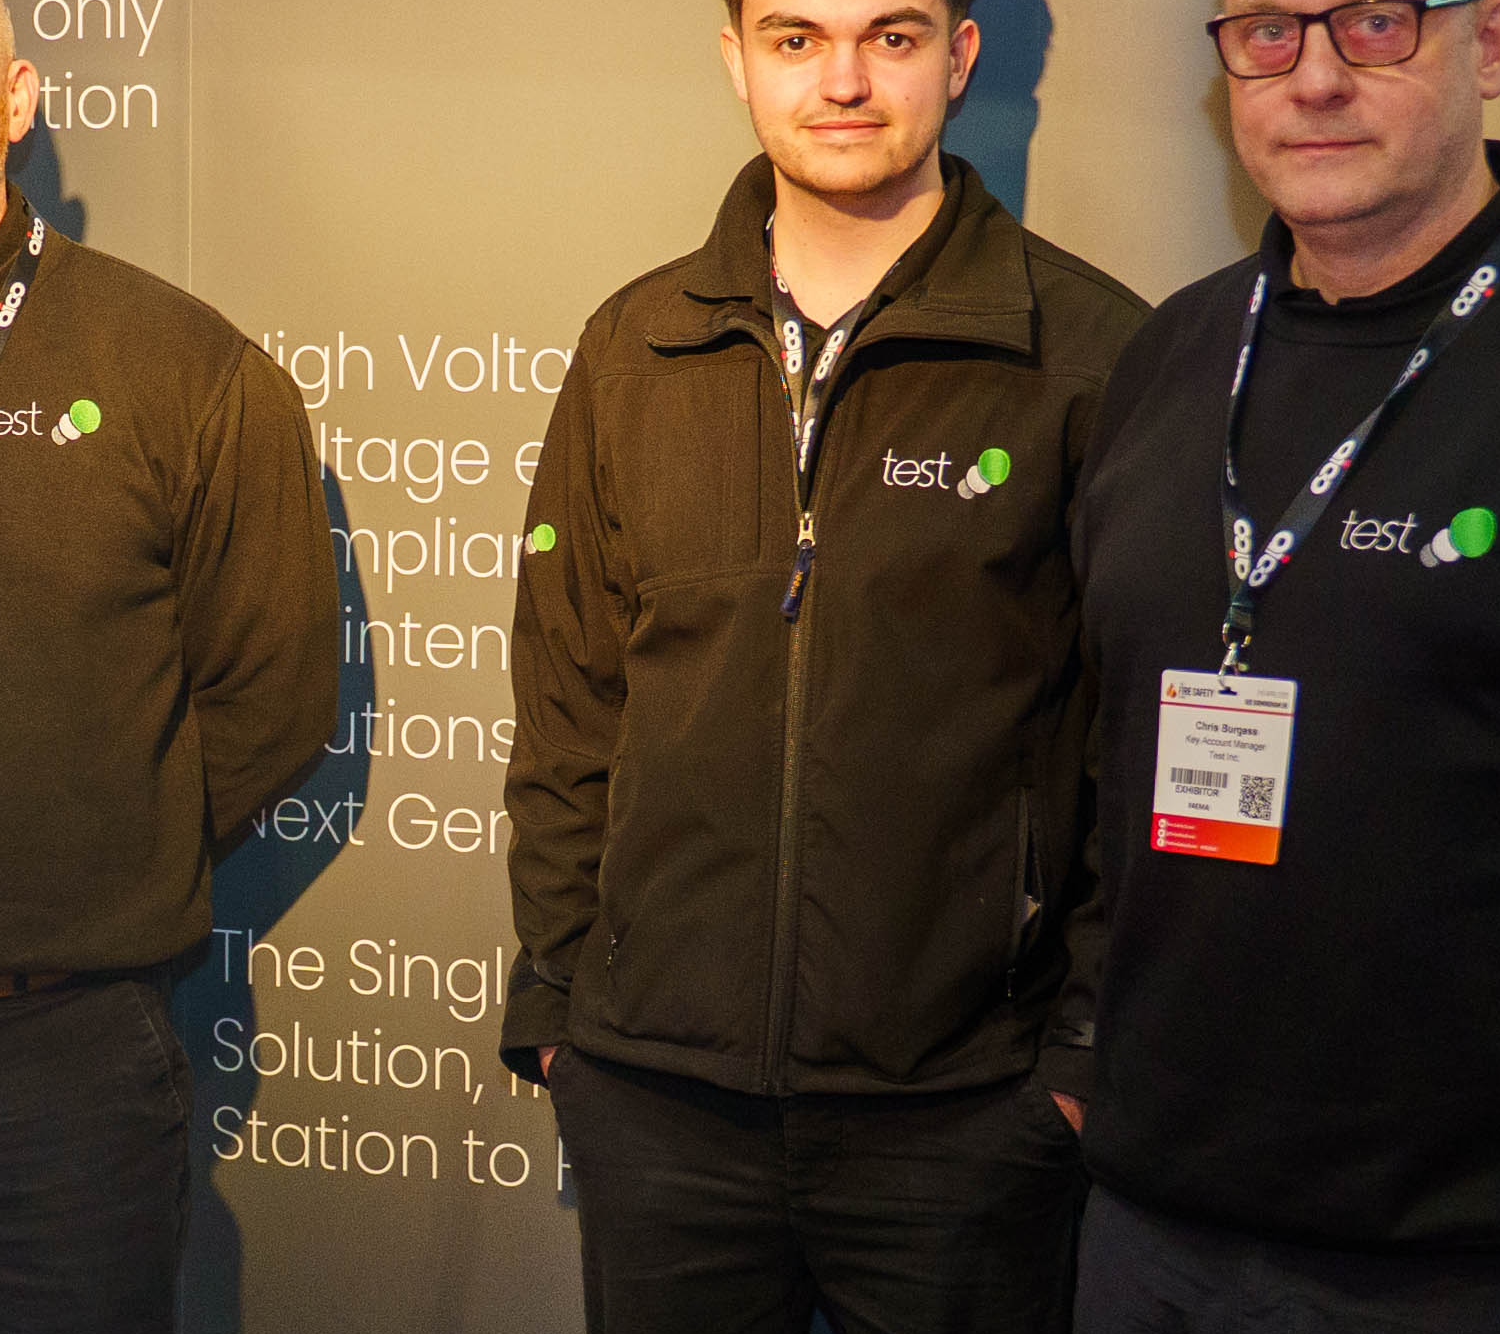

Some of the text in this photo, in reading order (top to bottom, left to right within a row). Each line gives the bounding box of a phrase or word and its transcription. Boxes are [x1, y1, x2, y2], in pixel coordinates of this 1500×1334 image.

[30, 74, 159, 131] tion
[1451, 265, 1497, 317] aico
[263, 330, 577, 410] igh Volta
[320, 421, 490, 504] ltage
[882, 448, 952, 490] test
[1248, 529, 1295, 588] aico
[1340, 511, 1418, 554] test
[344, 604, 509, 671] inten
[325, 698, 517, 764] utions
[1195, 721, 1219, 731] Chris
[1202, 737, 1232, 747] Account
[1233, 741, 1266, 752] Manager
[1209, 750, 1225, 760] Test
[1175, 785, 1219, 797] EXHIBITOR
[212, 928, 503, 1023] The Singl
[212, 1017, 484, 1105] Solution,
[212, 1105, 438, 1180] Station
[462, 1129, 530, 1187] to
